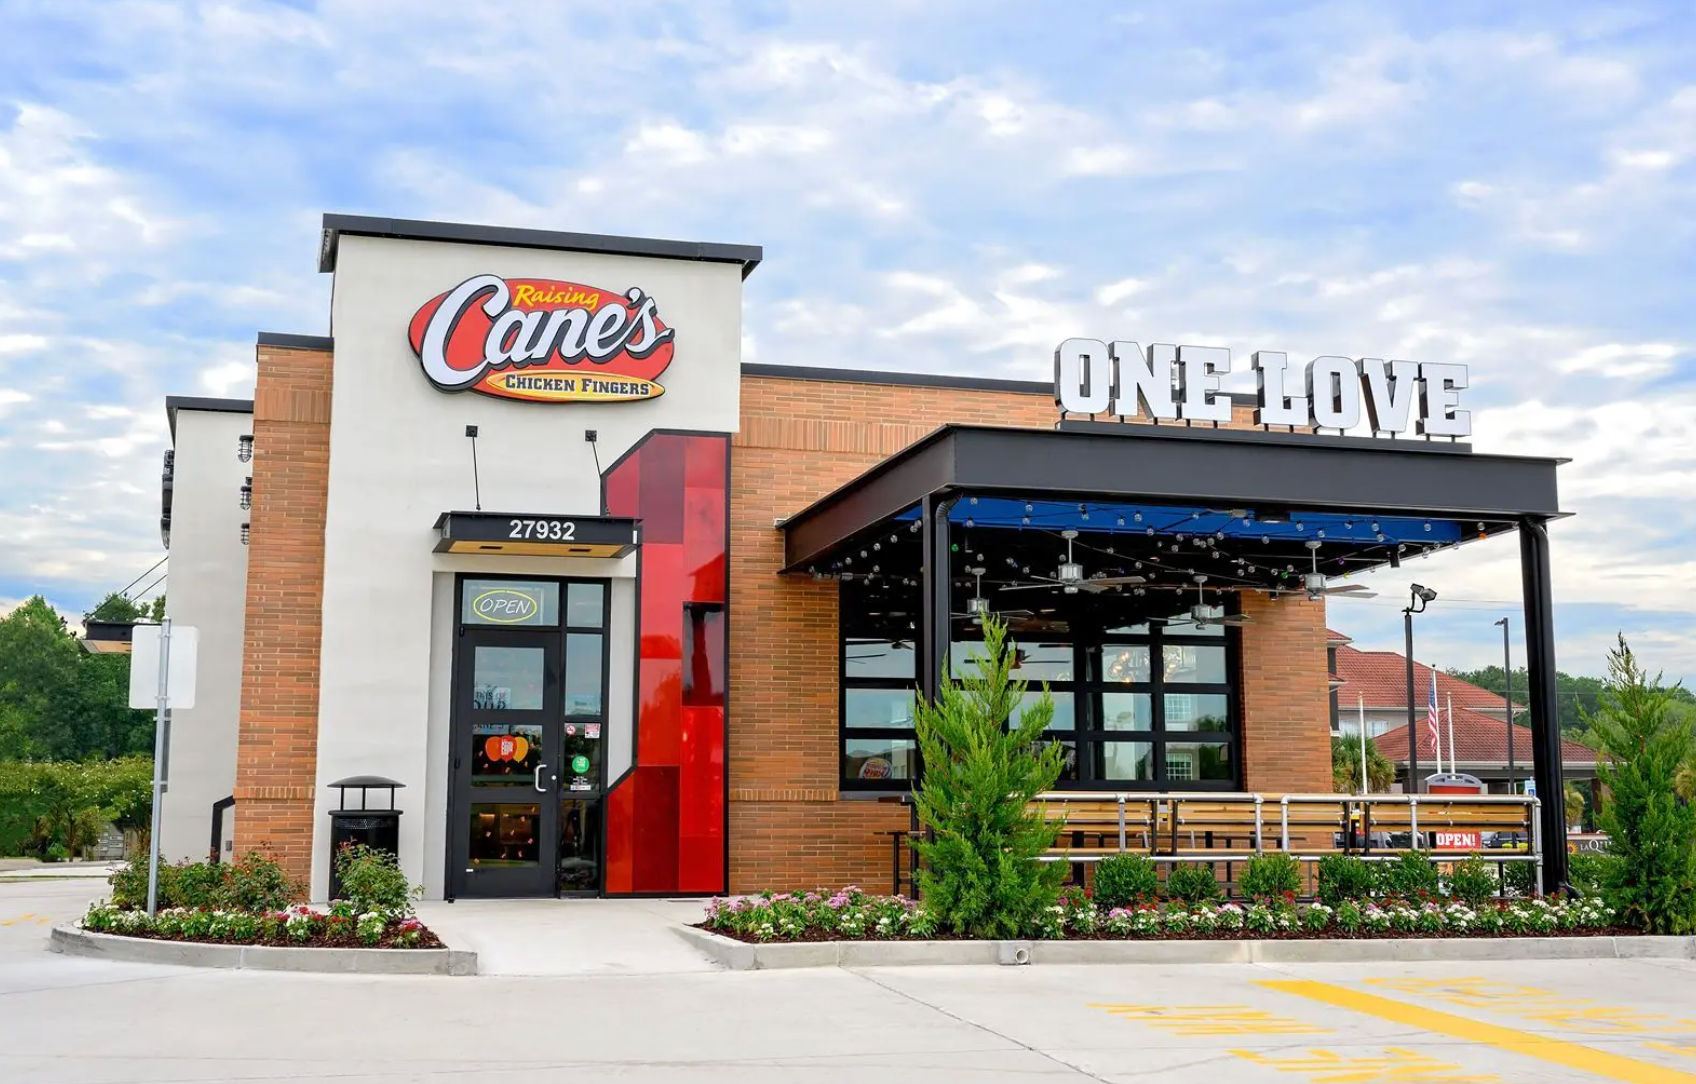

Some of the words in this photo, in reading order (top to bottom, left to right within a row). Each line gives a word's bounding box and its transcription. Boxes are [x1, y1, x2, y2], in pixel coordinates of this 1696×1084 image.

[513, 284, 599, 310] Raising
[420, 273, 674, 389] Cane's
[505, 374, 575, 392] CHICKEN
[581, 378, 650, 396] FINGERS
[1054, 337, 1232, 422] ONE
[1251, 350, 1472, 438] LOVE
[509, 519, 575, 540] 27932
[479, 597, 532, 615] OPEN
[1436, 833, 1476, 847] OPEN!
